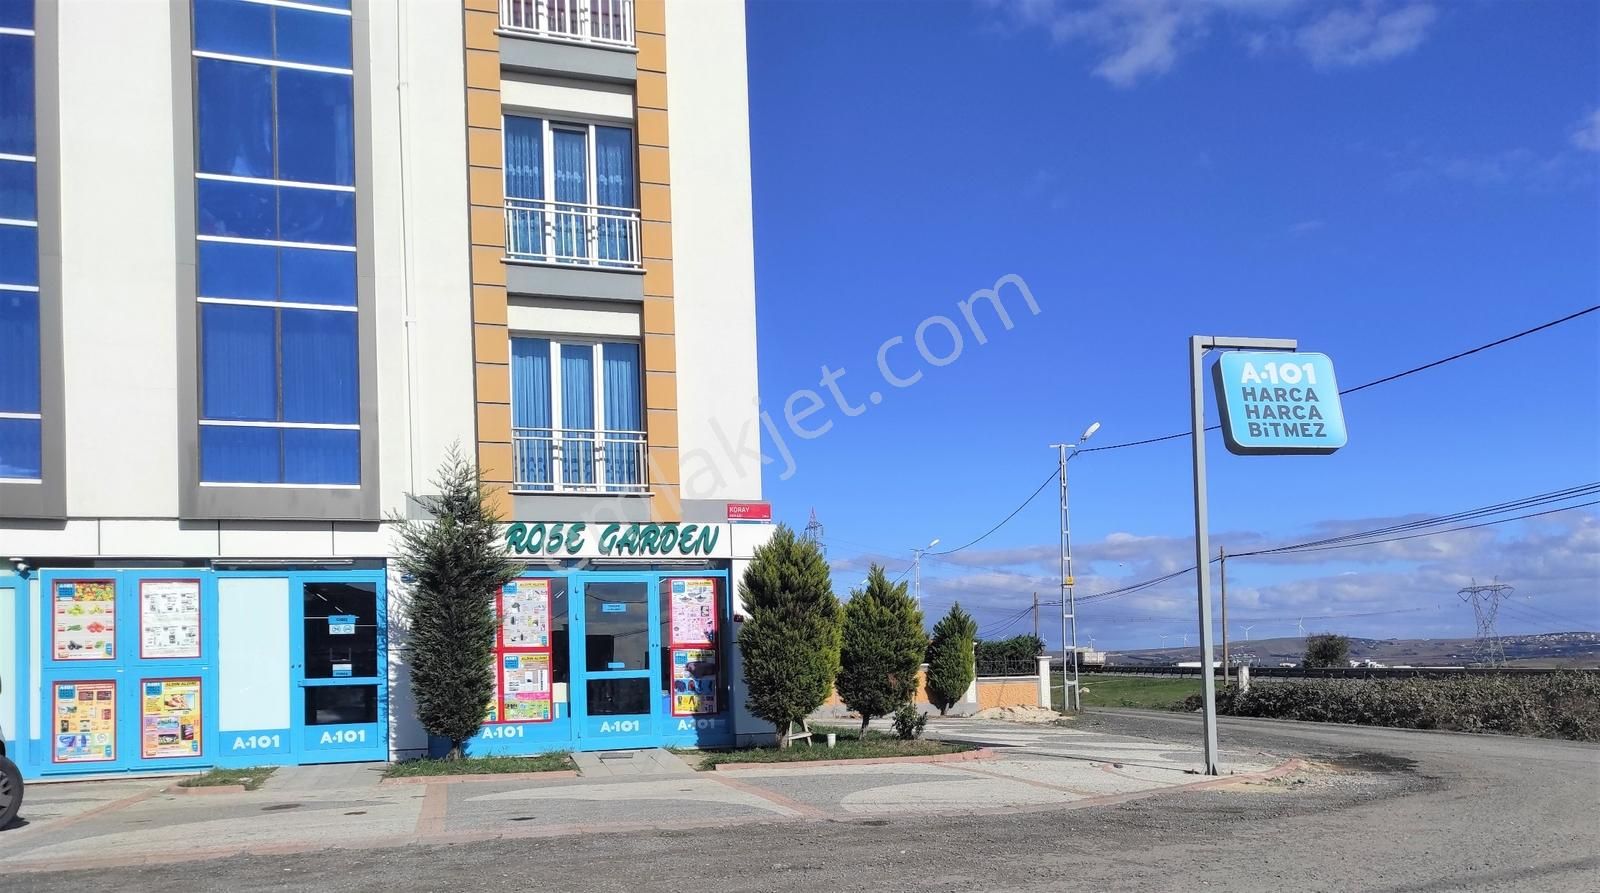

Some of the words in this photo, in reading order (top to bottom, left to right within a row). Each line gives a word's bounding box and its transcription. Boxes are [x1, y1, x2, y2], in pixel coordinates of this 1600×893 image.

[1242, 387, 1319, 402] HARCA
[1245, 405, 1323, 420] HARCA
[505, 521, 586, 555] ROSE
[598, 522, 719, 556] GARDEN
